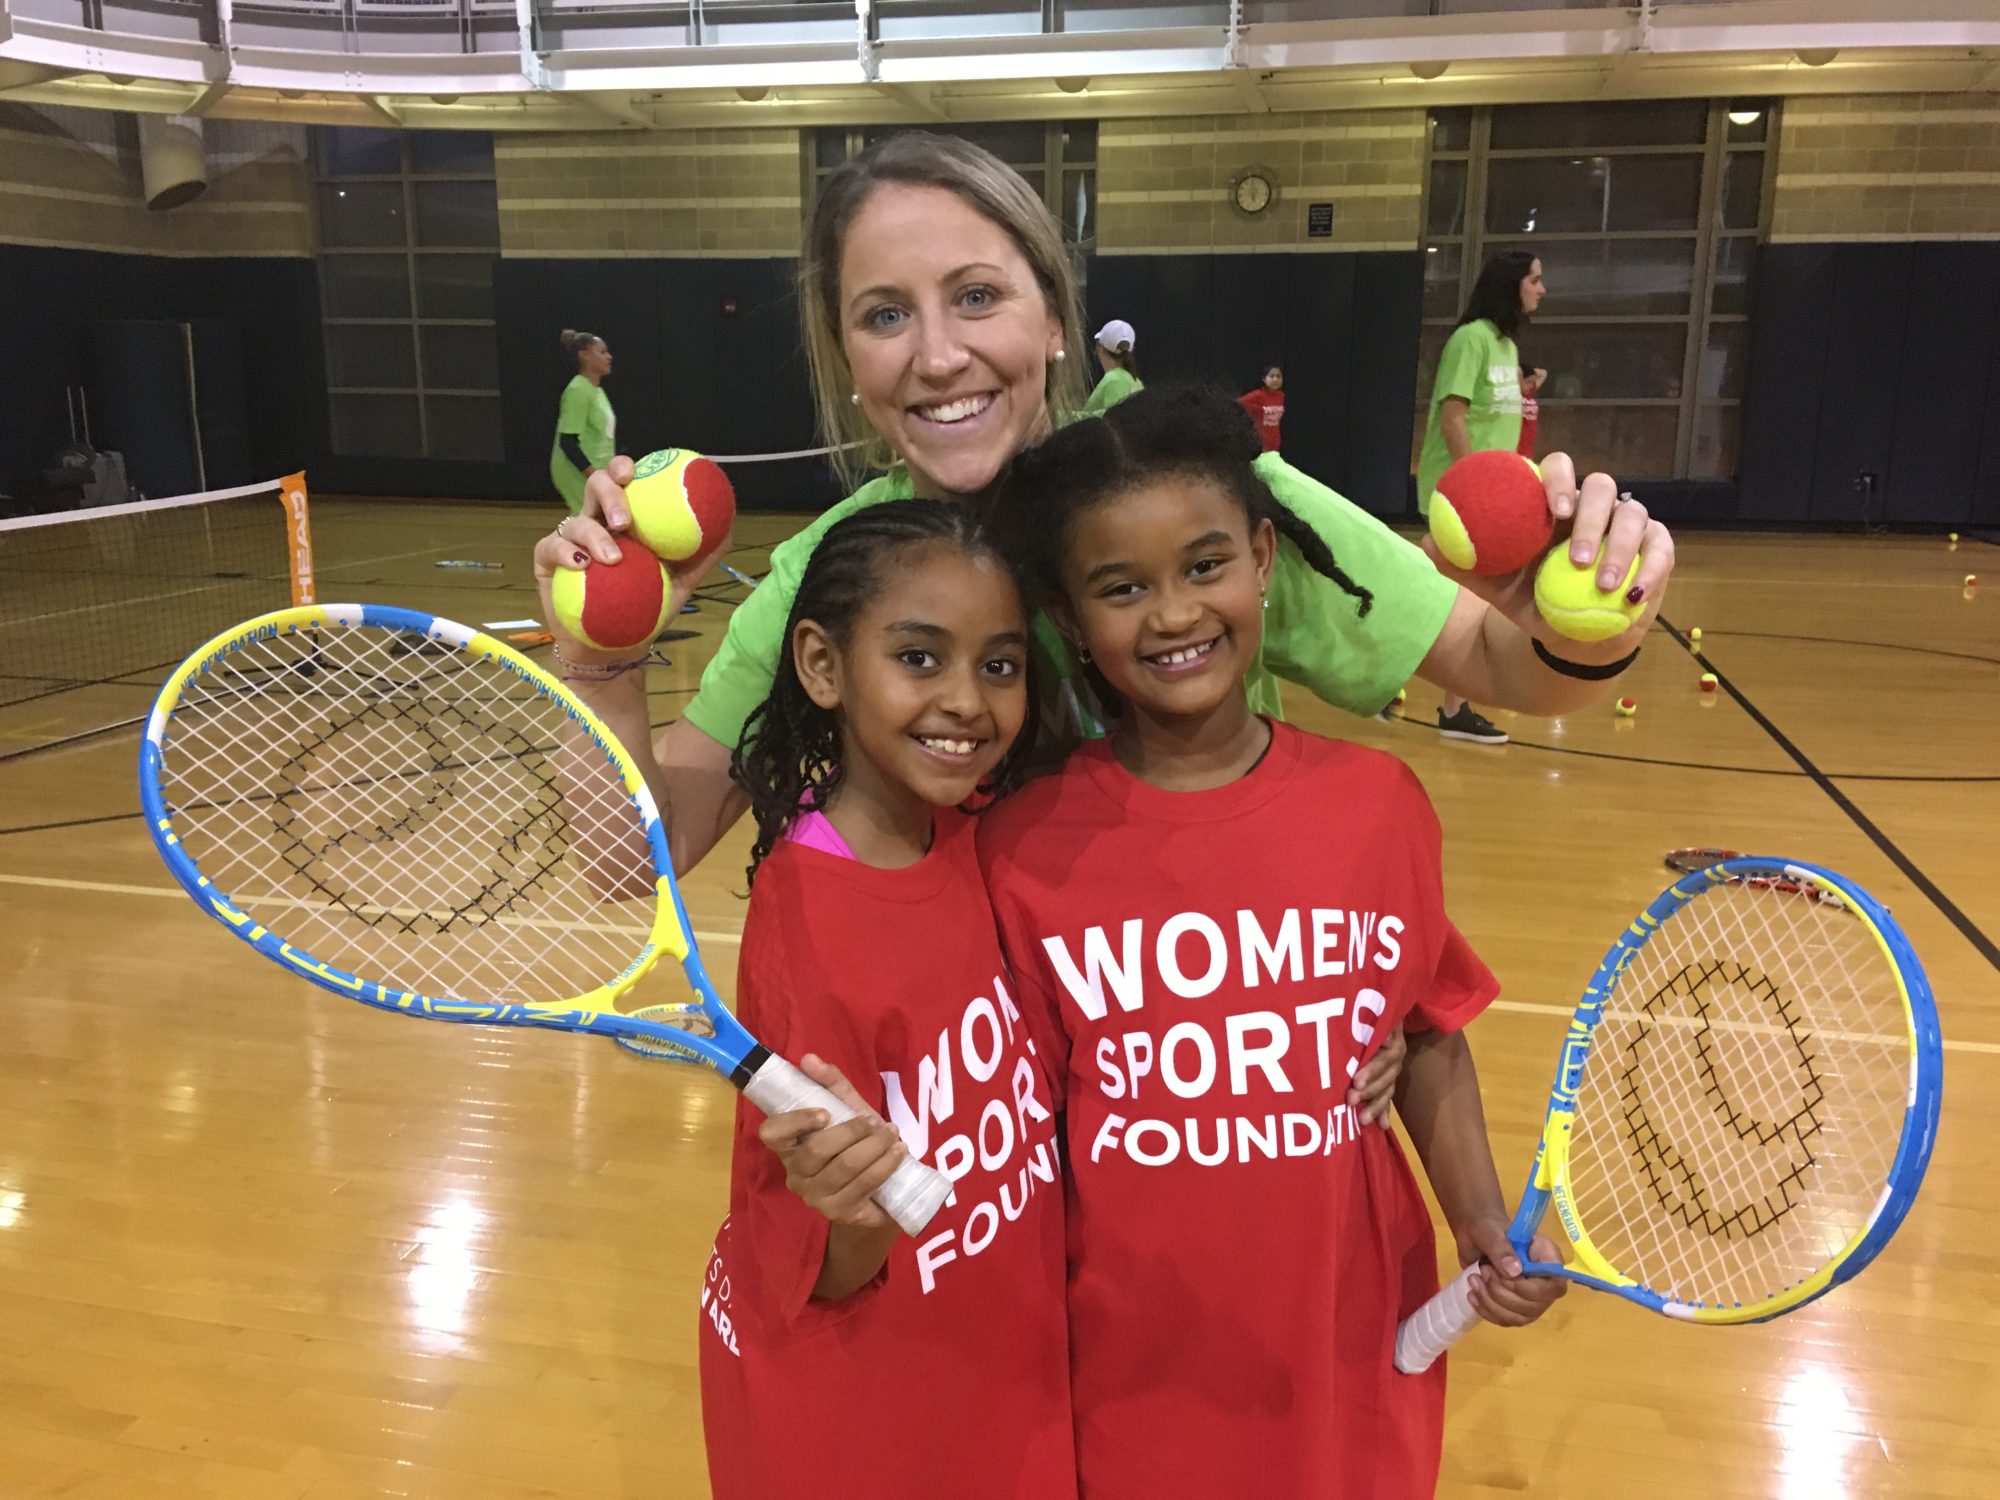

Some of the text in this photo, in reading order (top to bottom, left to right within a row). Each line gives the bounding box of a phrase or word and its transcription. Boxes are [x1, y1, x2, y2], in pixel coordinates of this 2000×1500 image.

[290, 490, 313, 604] HEAD
[1041, 908, 1405, 1021] WOMEN'S
[1090, 1103, 1361, 1167] FOUNDATI
[916, 1135, 1062, 1296] FOUN
